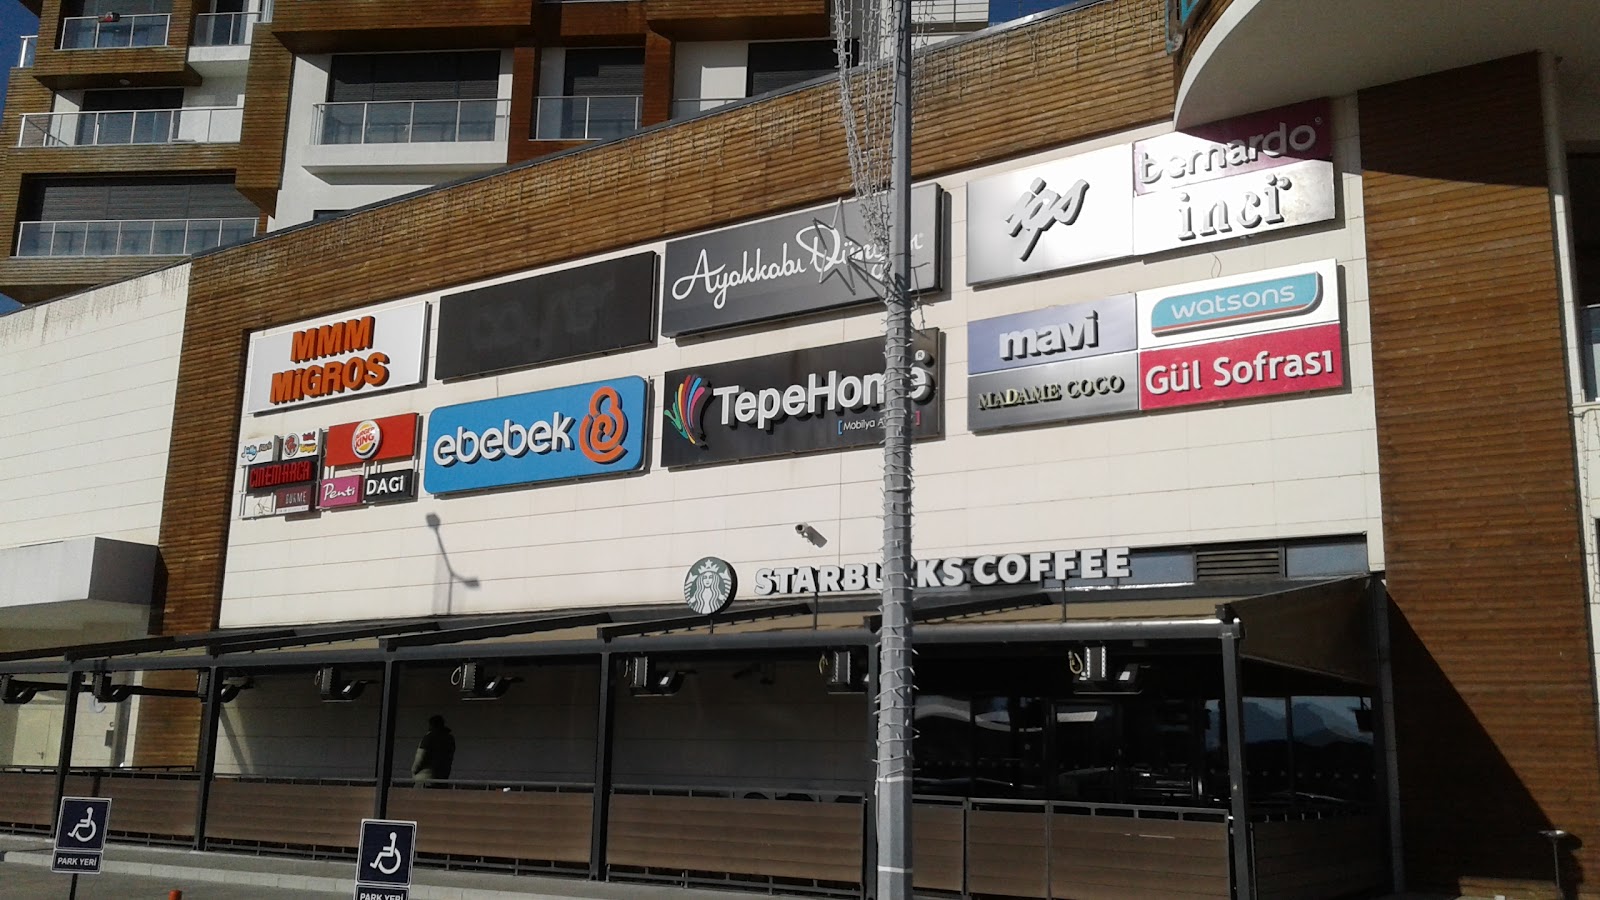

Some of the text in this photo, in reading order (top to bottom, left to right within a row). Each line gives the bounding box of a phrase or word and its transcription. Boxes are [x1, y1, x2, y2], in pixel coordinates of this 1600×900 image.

[1138, 121, 1317, 185] bernardo
[671, 242, 806, 309] Ayakkabı
[1171, 283, 1296, 320] watsons
[290, 315, 375, 363] MMM
[999, 310, 1098, 362] mavi
[978, 375, 1125, 410] MADAME COCO
[1146, 348, 1334, 395] Gül Sofrası
[355, 433, 375, 447] KING
[432, 411, 574, 467] ebebek
[322, 483, 356, 501] Penti
[754, 547, 1130, 595] STARBUKS COFFEE
[58, 857, 78, 866] PARK
